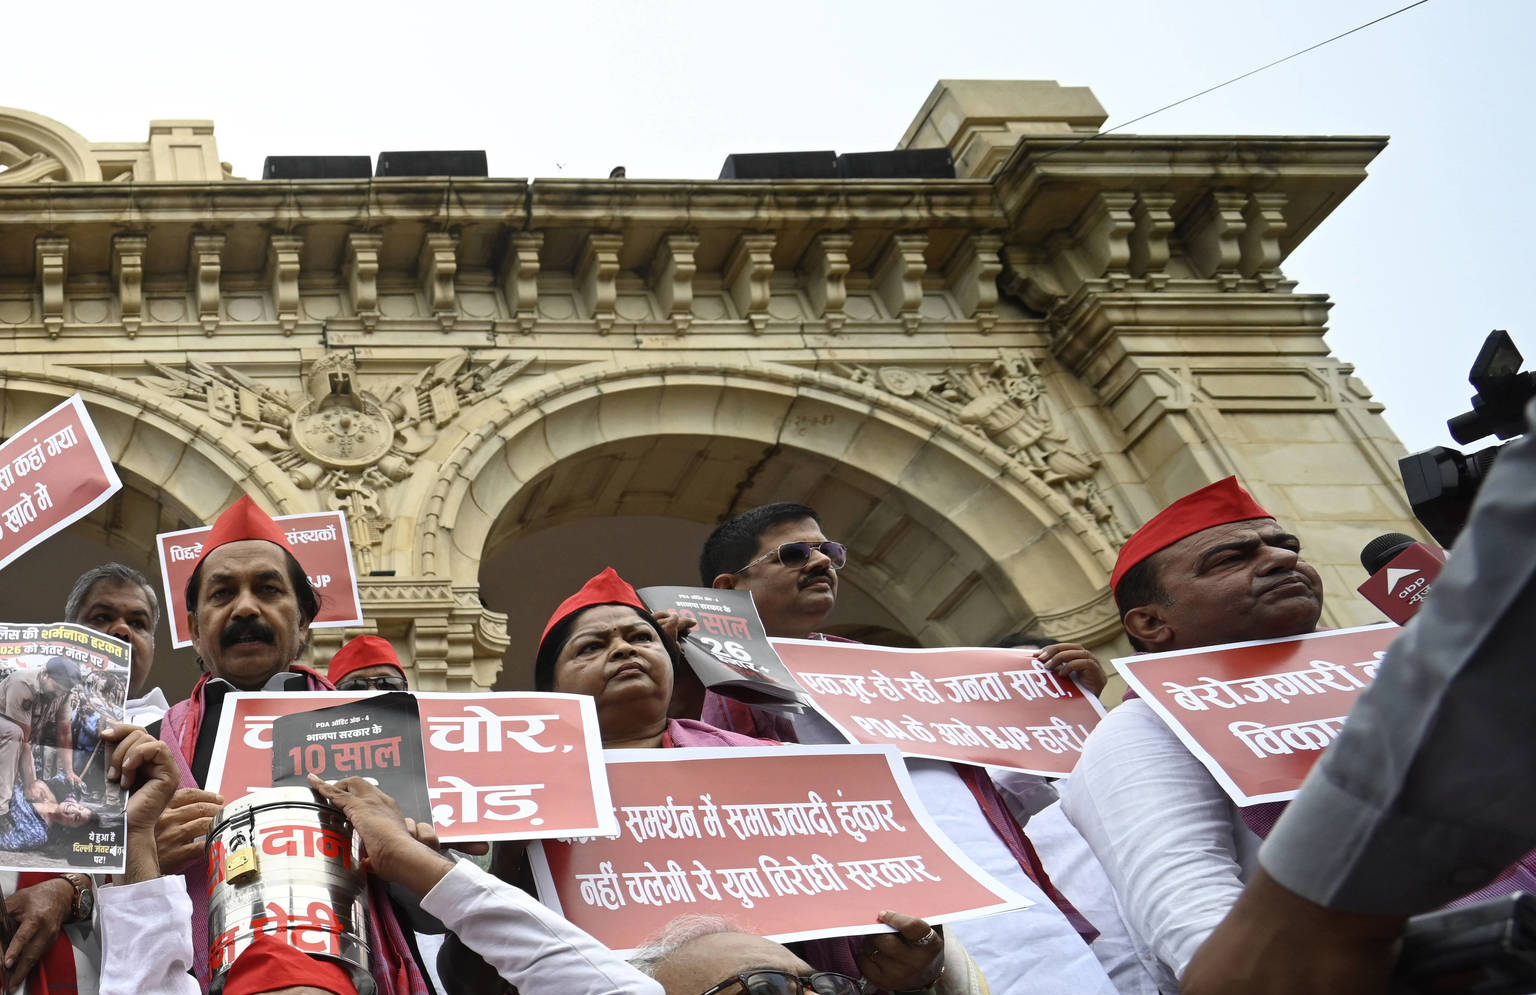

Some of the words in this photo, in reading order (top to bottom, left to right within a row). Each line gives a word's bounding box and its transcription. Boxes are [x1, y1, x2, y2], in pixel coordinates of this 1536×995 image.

[13, 438, 47, 477] कहां
[44, 425, 78, 456] गया
[2, 493, 37, 533] खाते
[1399, 577, 1425, 599] abp
[23, 627, 39, 640] की
[41, 626, 89, 645] शर्मनाक
[91, 635, 122, 658] हरकत
[697, 611, 752, 640] साल
[23, 642, 38, 654] को
[40, 644, 63, 657] जंतर
[64, 646, 88, 663] मंतर
[89, 653, 105, 668] पर
[700, 637, 752, 661] 26
[797, 671, 872, 704] एकजुट
[871, 669, 900, 701] हो
[895, 671, 944, 704] रही
[936, 672, 1012, 702] जनता
[1011, 659, 1073, 699] सारी,
[306, 731, 337, 741] भाजपा
[338, 727, 370, 740] सरकार
[371, 723, 382, 735] के
[427, 705, 573, 754] चोर,
[851, 716, 902, 740] PDA
[900, 714, 934, 743] के
[930, 718, 988, 747] आगे
[978, 726, 1032, 751] BJP
[288, 743, 325, 776] 10
[331, 736, 402, 771] साल
[622, 795, 702, 843] समर्थन
[699, 793, 726, 840] में
[723, 790, 838, 842] समाजवादी
[832, 789, 906, 842] हुंकार
[73, 842, 93, 852] दिल्ली
[259, 825, 352, 870] दान
[576, 861, 625, 910] नहीं
[624, 861, 696, 904] चलेगी
[692, 859, 721, 902] ये
[715, 866, 772, 908] युवा
[758, 853, 848, 899] विरोधी
[840, 856, 941, 892] सरकार
